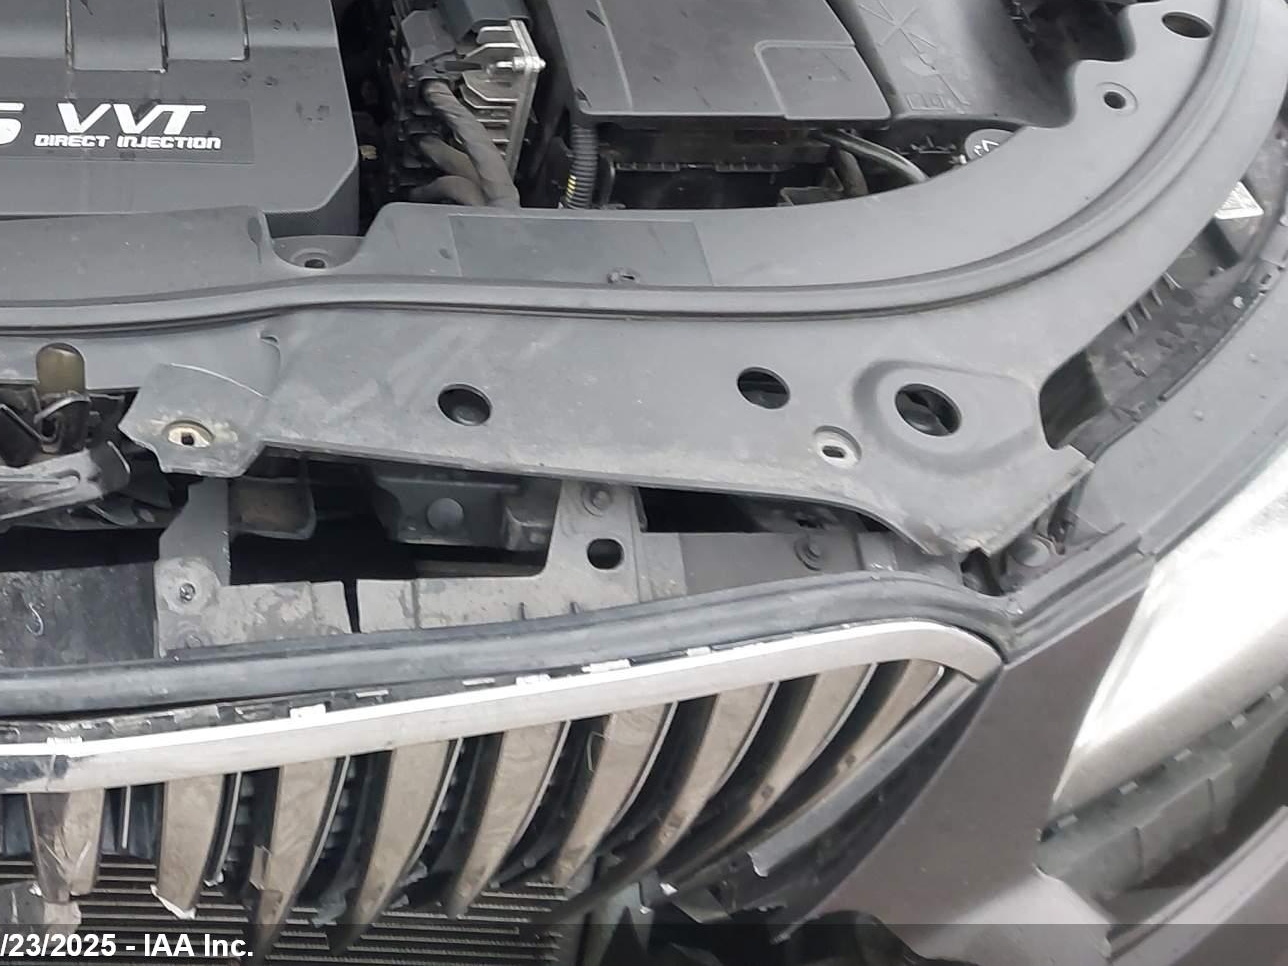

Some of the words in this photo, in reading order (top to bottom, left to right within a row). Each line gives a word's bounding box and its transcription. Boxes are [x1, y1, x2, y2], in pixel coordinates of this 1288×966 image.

[57, 103, 207, 135] VVT
[34, 135, 111, 148] DIRECT
[116, 136, 222, 149] INJECTION
